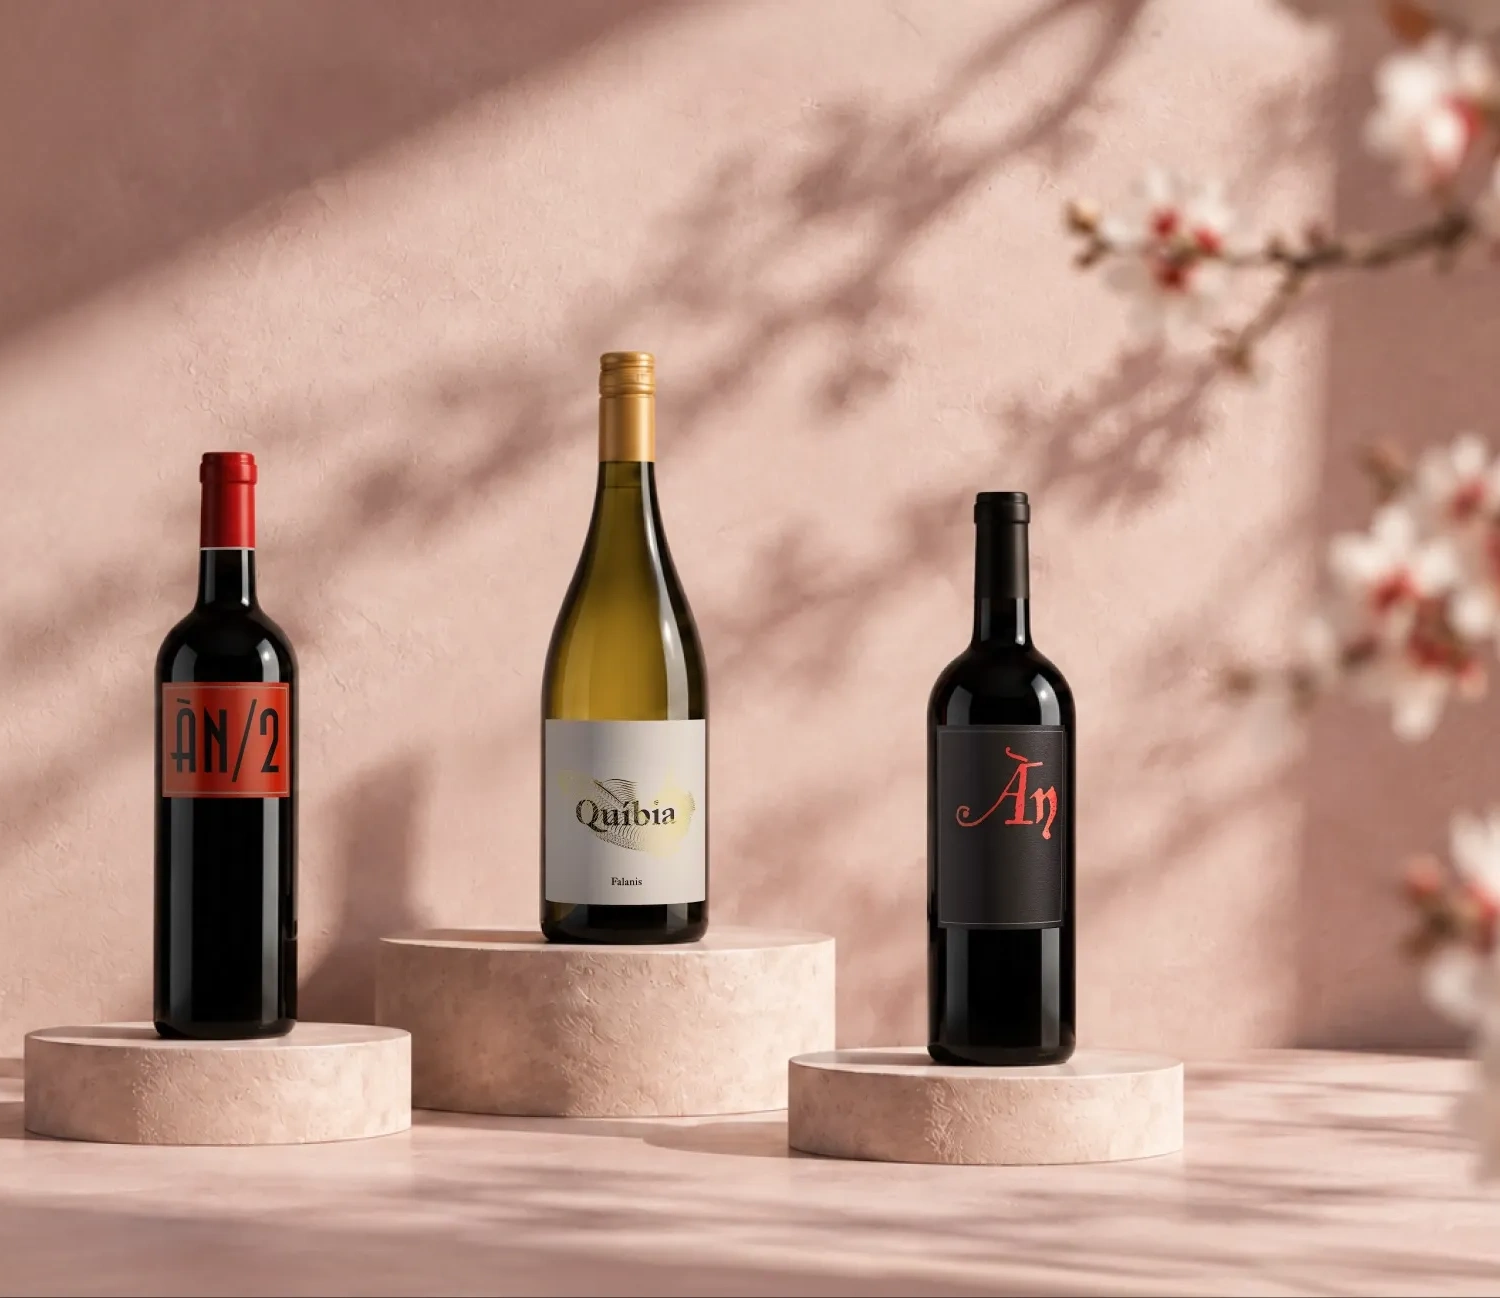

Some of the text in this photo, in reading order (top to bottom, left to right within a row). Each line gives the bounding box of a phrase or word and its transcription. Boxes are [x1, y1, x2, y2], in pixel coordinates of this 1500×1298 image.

[170, 697, 280, 783] ÀN/2
[575, 799, 677, 833] Quíbia
[610, 876, 643, 886] Falanis
